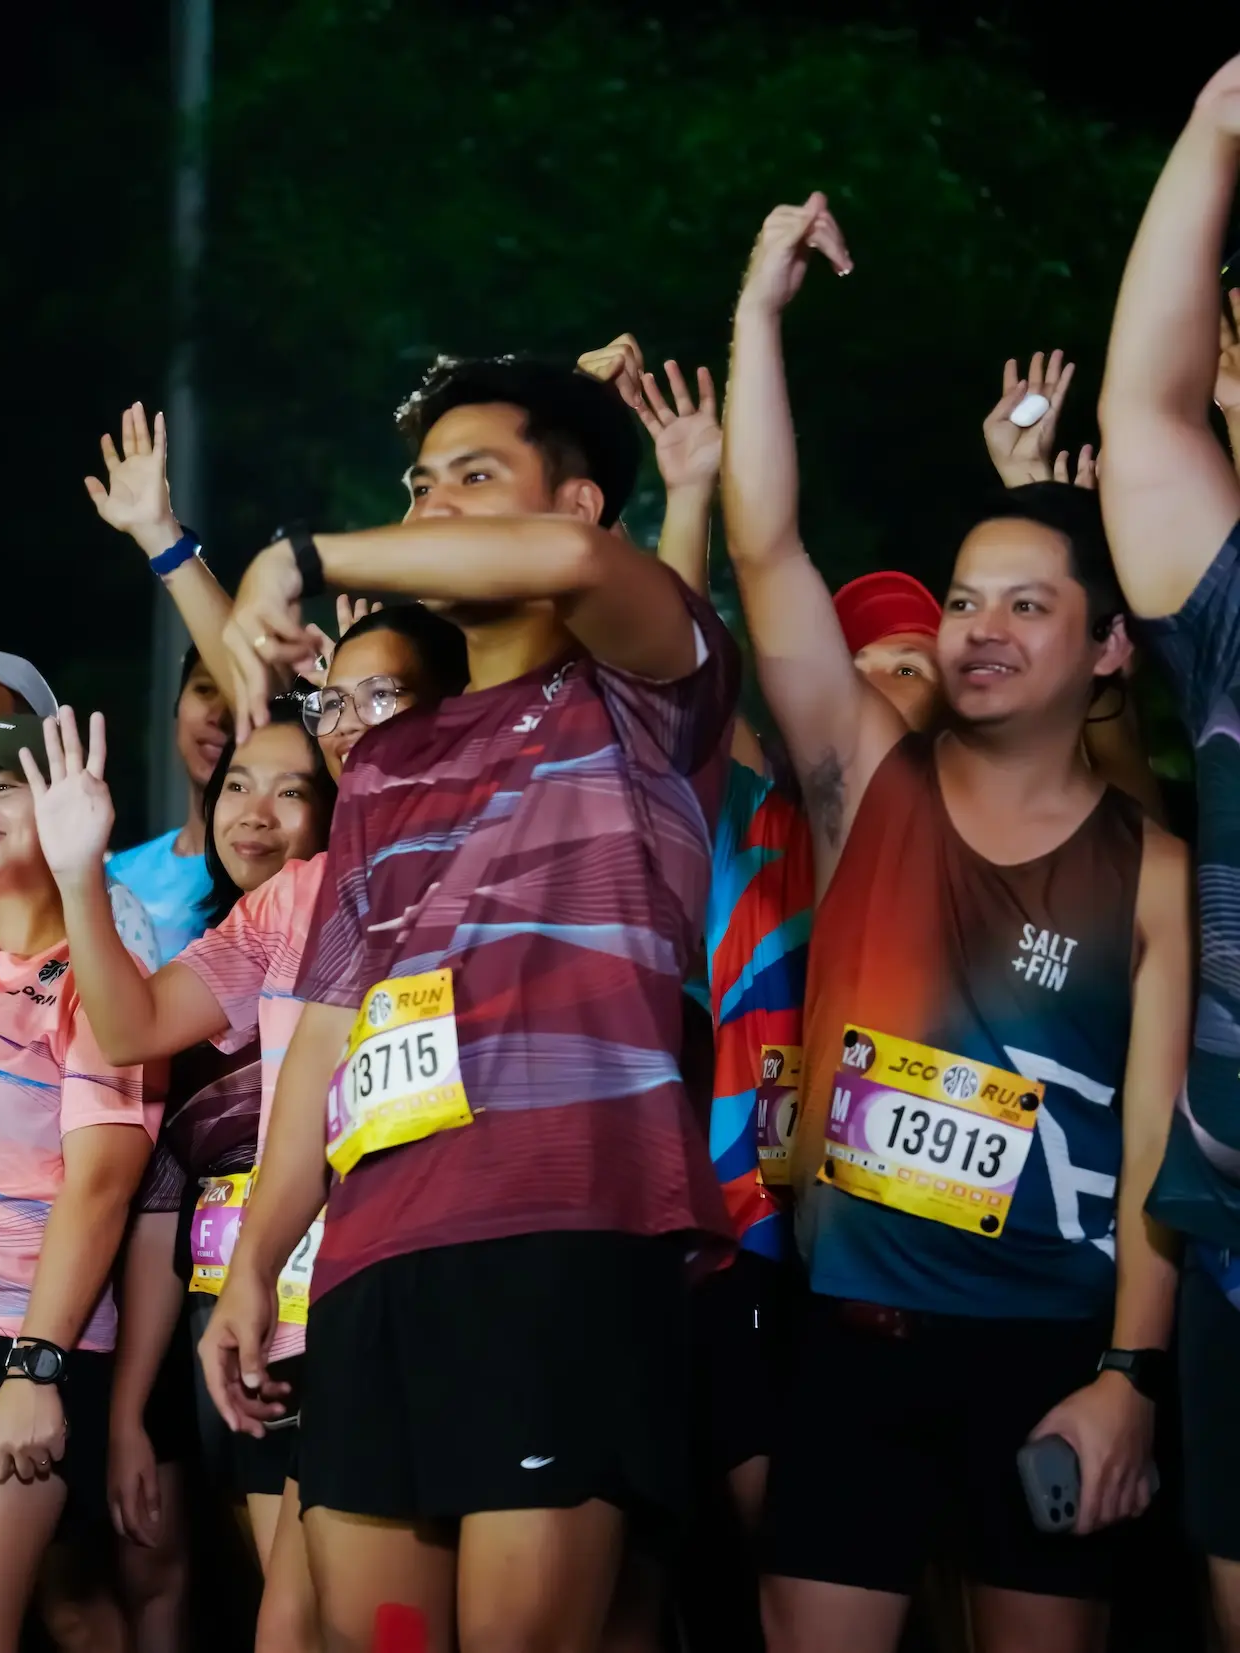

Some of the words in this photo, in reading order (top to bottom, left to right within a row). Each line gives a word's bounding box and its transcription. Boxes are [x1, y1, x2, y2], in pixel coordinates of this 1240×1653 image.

[1018, 923, 1078, 964] SALT
[397, 987, 444, 1008] RUN
[352, 1032, 438, 1103] 13715
[763, 1058, 782, 1079] 12K
[889, 1057, 939, 1081] JCO
[980, 1084, 1023, 1107] RU
[831, 1087, 851, 1122] M
[887, 1105, 1007, 1178] 13913
[204, 1185, 230, 1202] 12K
[200, 1220, 213, 1247] F
